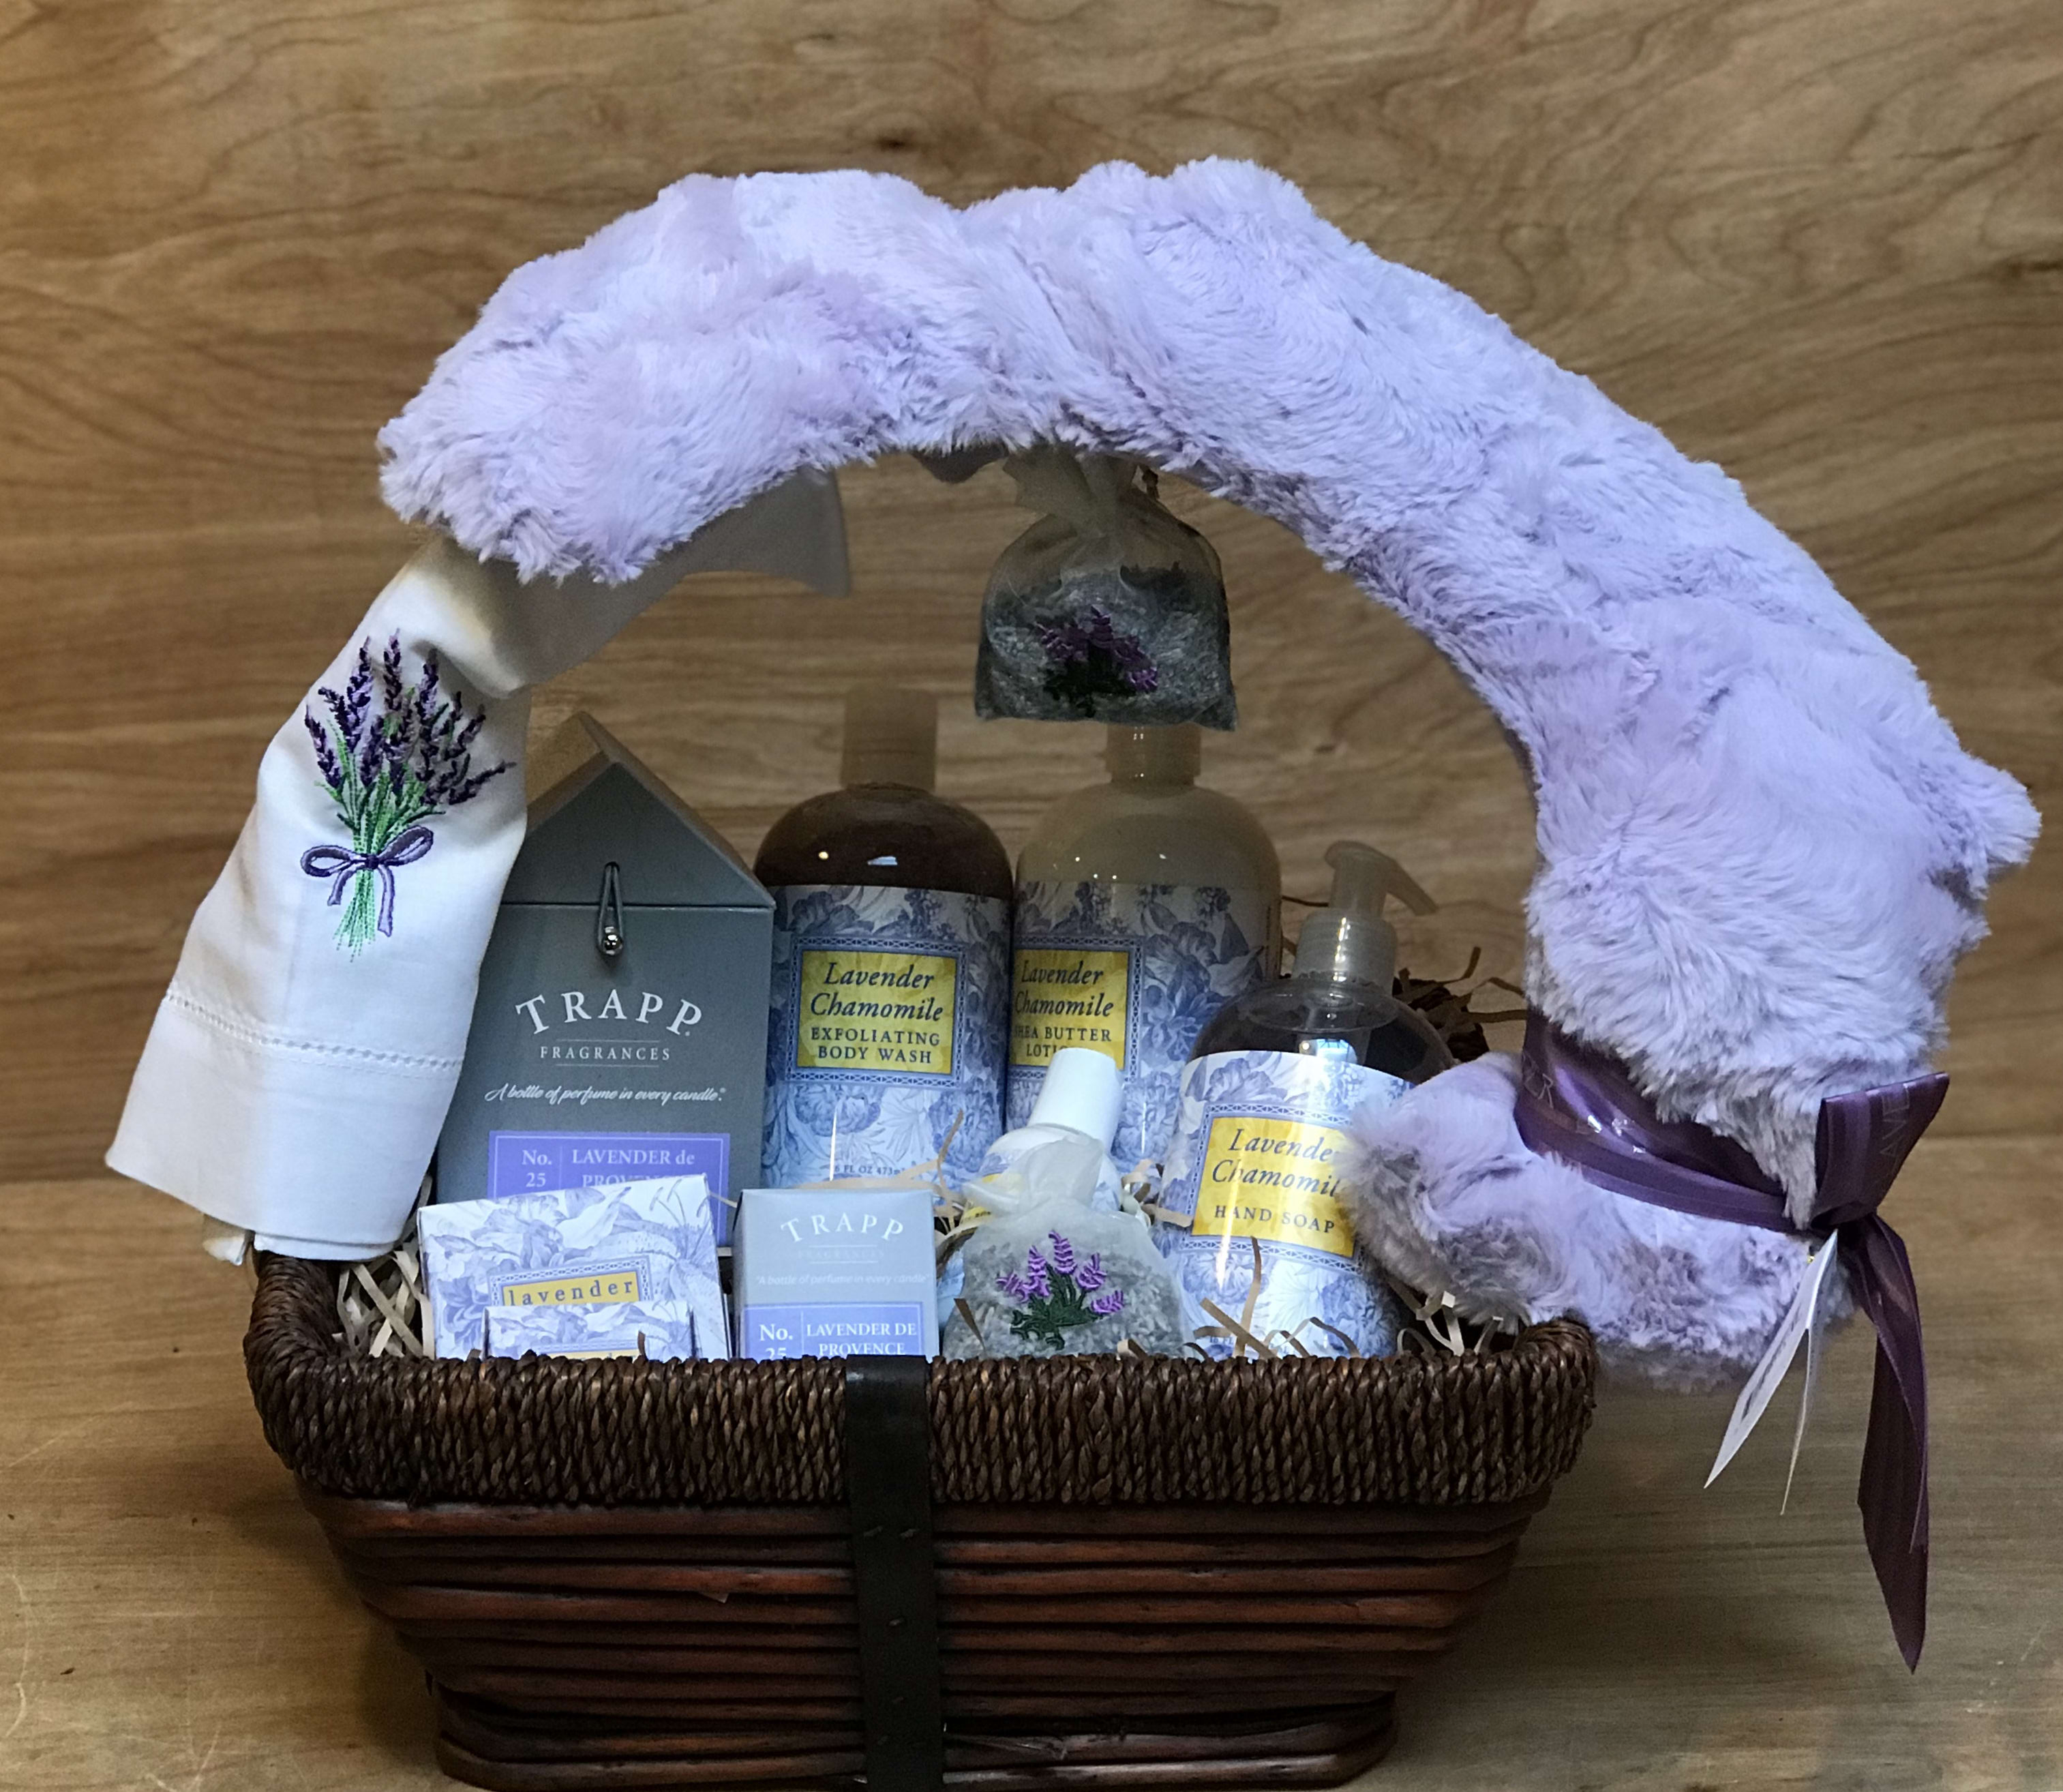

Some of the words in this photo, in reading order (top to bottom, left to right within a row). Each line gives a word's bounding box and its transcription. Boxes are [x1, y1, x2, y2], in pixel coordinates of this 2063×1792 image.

[824, 962, 934, 989] Lavender
[1021, 960, 1103, 985] Lavender
[515, 989, 702, 1035] TRAPP
[811, 992, 944, 1021] Chamomile
[1015, 990, 1114, 1017] Chamomile
[811, 1027, 940, 1046] EXFOLIATING
[1044, 1026, 1111, 1042] BUTTER
[540, 1046, 669, 1060] FRAGRANCES
[818, 1046, 868, 1060] BODY
[878, 1048, 931, 1063] WASH
[1026, 1043, 1067, 1057] LOTI
[485, 1083, 510, 1101] A
[507, 1085, 544, 1099] bottle
[545, 1086, 562, 1105] of
[556, 1086, 617, 1105] perfume
[618, 1088, 633, 1100] in
[635, 1089, 672, 1106] every
[1228, 1129, 1338, 1162] Lavende
[522, 1150, 552, 1165] No.
[572, 1149, 671, 1165] LAVENDER
[676, 1150, 695, 1165] de
[526, 1173, 546, 1187] 25
[1212, 1159, 1340, 1197] Chamomil
[780, 1212, 904, 1242] TRAPP
[1214, 1205, 1272, 1221] HAND
[1281, 1212, 1335, 1234] SOAP
[509, 1279, 633, 1306] lavender
[759, 1324, 794, 1341] No.
[806, 1323, 890, 1336] LAVENDER
[894, 1323, 917, 1336] DE
[818, 1343, 905, 1356] PROVENCE
